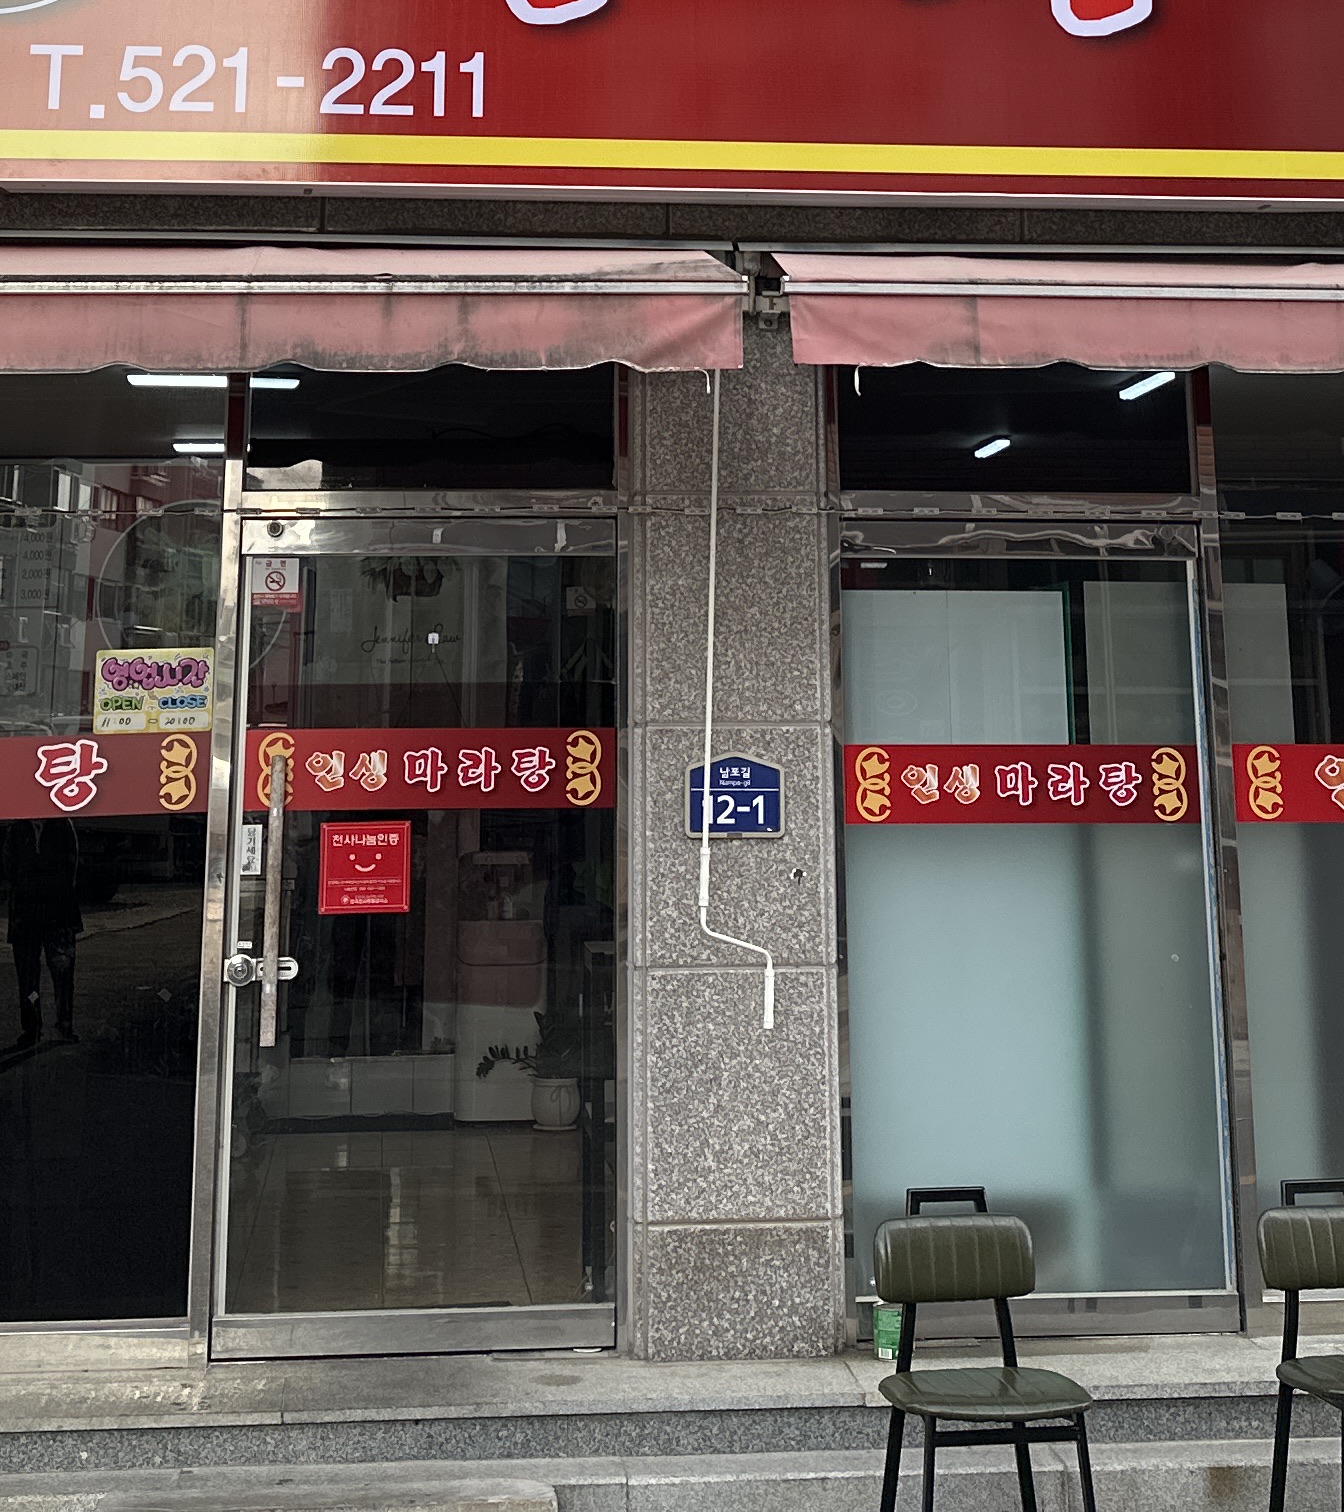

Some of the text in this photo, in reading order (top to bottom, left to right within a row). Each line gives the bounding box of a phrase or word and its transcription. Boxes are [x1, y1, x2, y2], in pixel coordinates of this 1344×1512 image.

[30, 45, 487, 120] T.521-2211
[100, 656, 210, 692] 영업시간
[100, 694, 208, 711] OPEN CLOSE
[305, 746, 556, 792] 인생 마라탕
[900, 760, 1143, 807] 인생 마라탕
